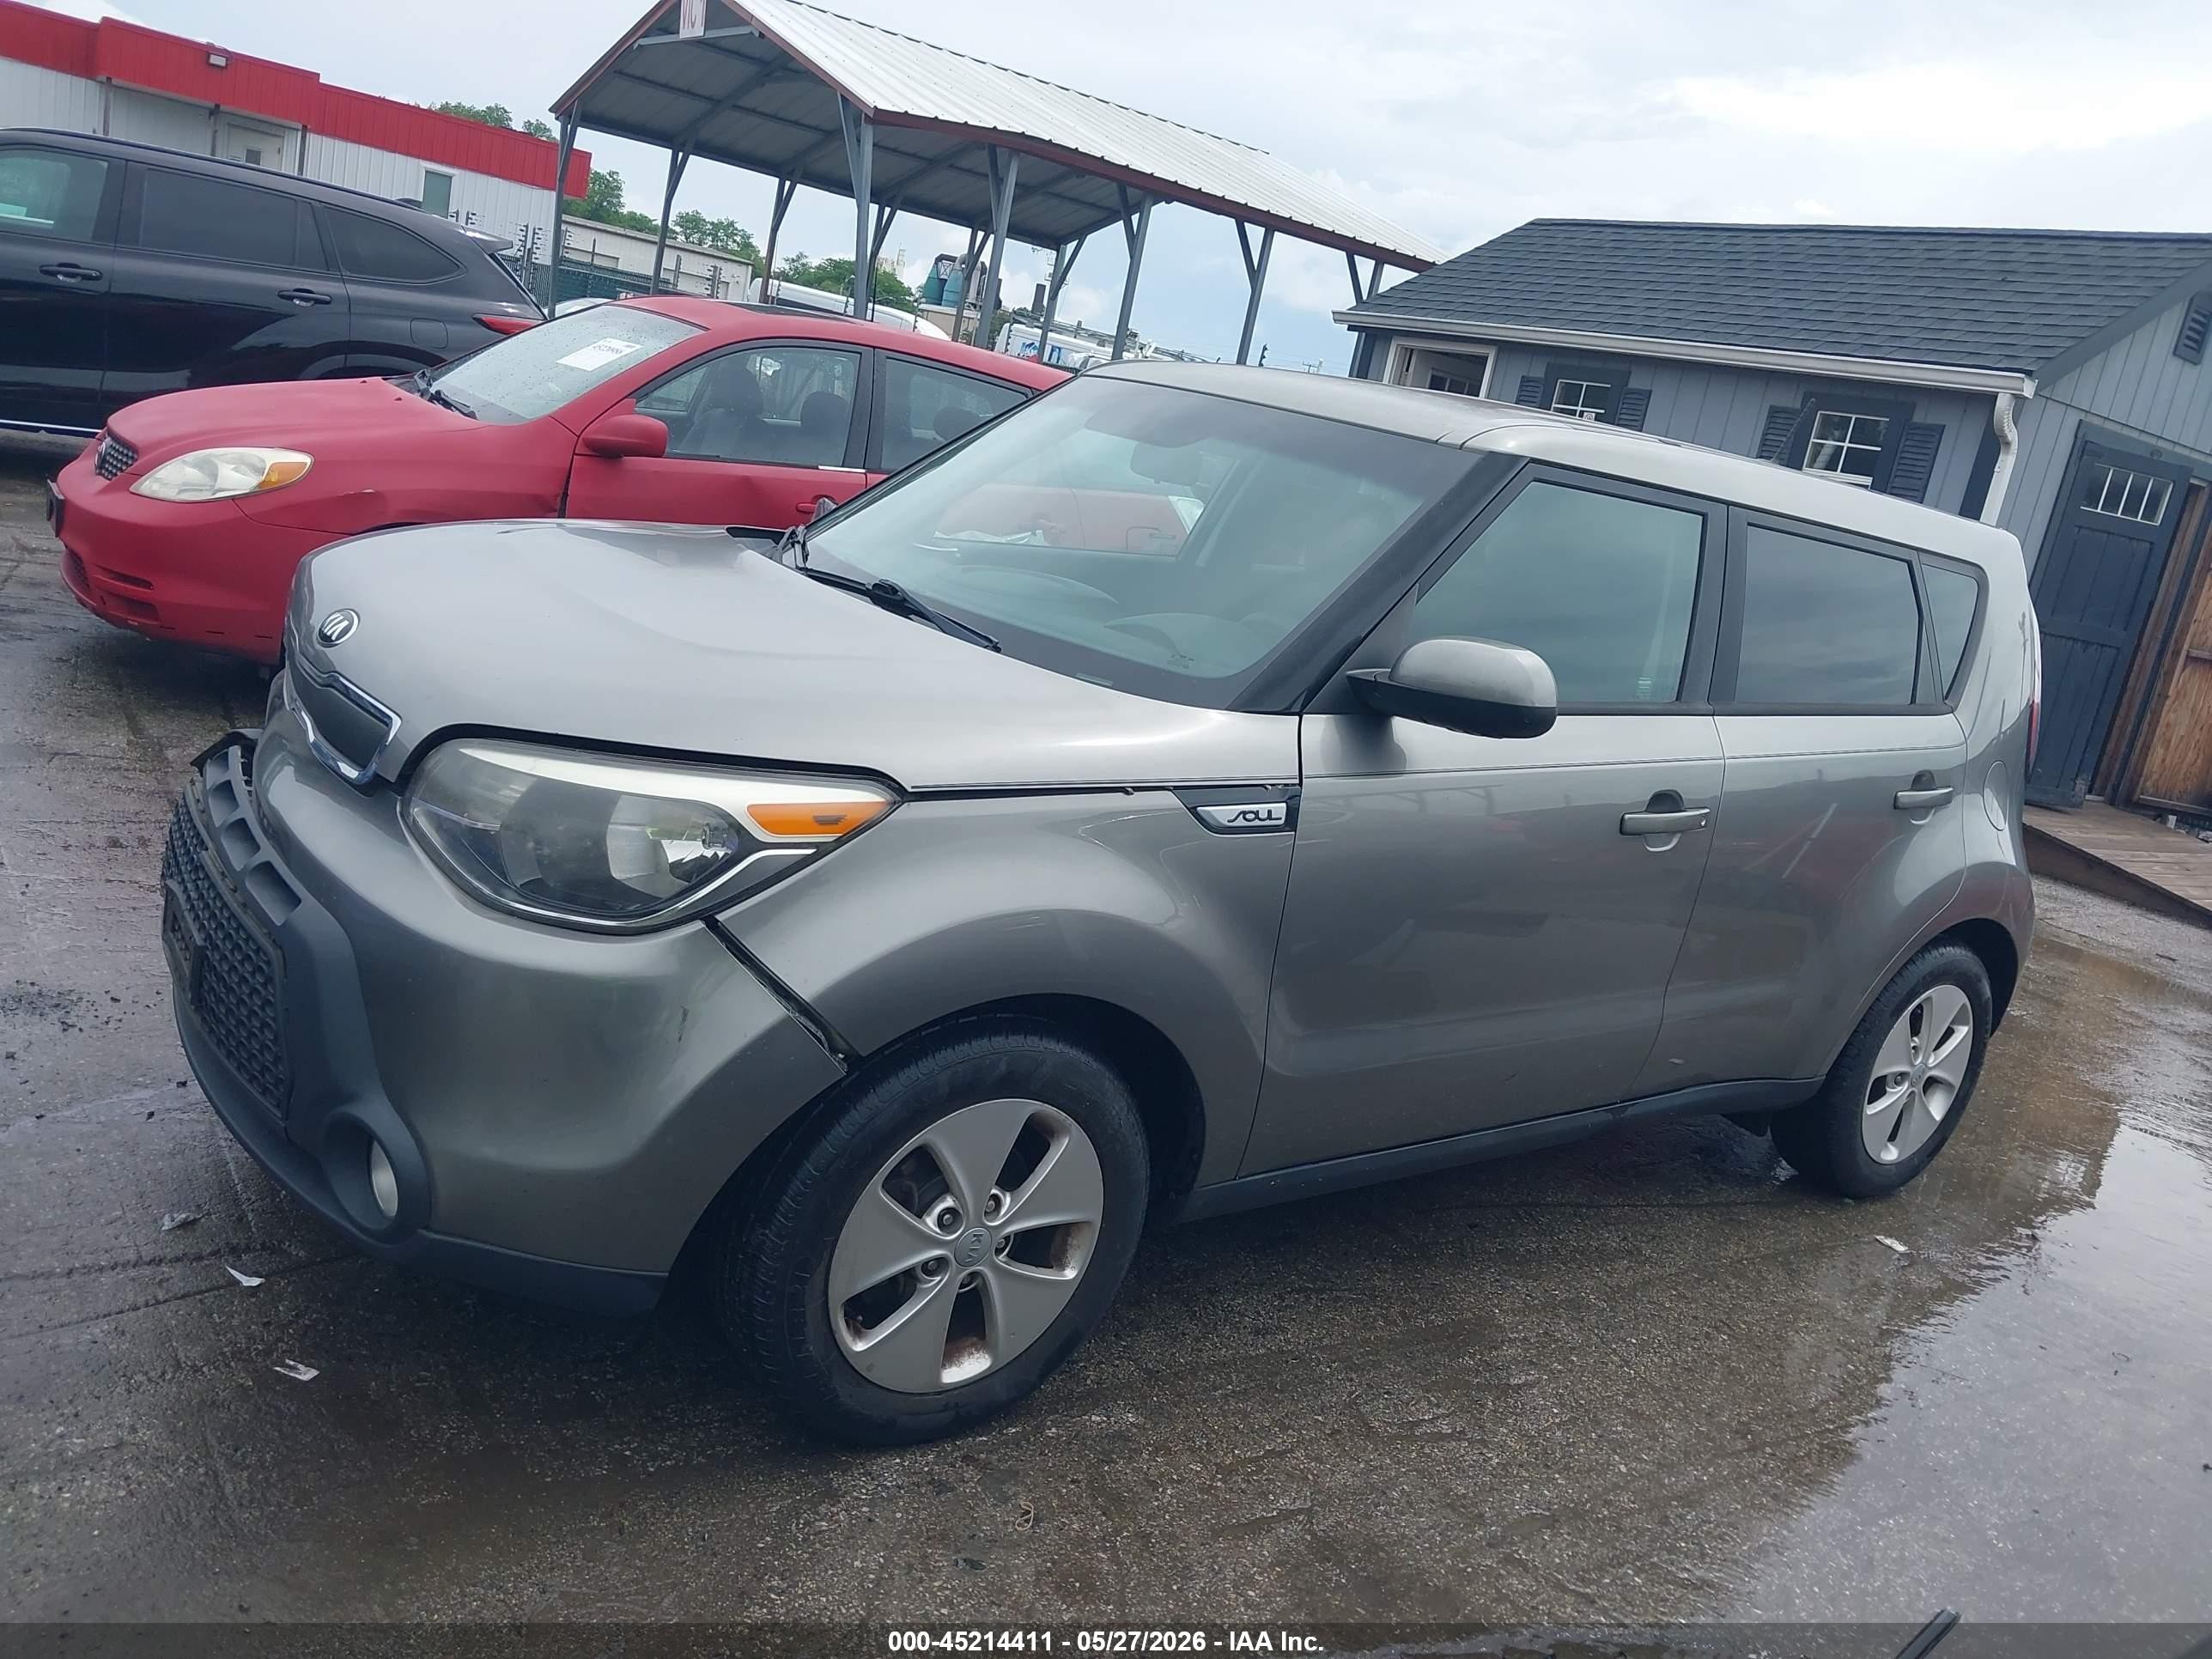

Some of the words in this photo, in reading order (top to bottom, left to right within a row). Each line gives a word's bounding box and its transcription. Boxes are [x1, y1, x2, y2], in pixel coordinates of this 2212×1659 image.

[321, 611, 349, 641] KIA
[1227, 809, 1282, 823] SOUL
[964, 1232, 984, 1262] KIA
